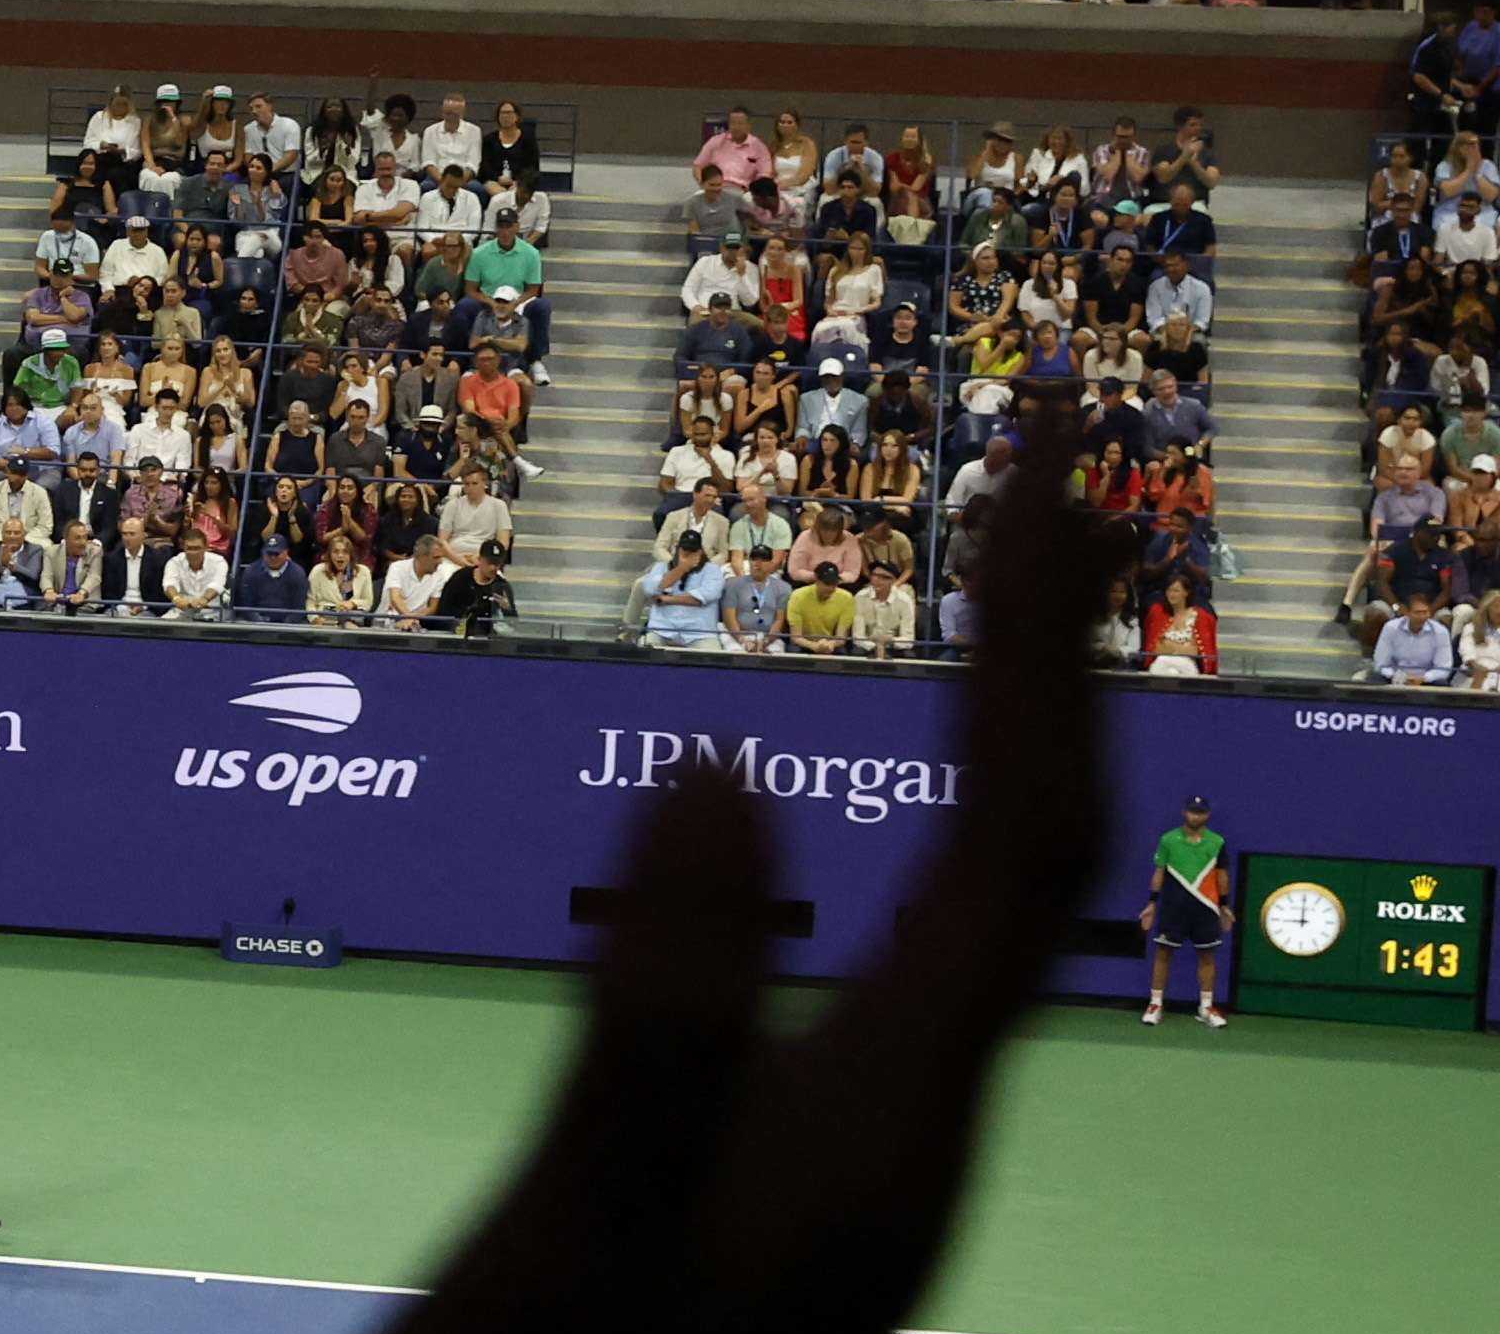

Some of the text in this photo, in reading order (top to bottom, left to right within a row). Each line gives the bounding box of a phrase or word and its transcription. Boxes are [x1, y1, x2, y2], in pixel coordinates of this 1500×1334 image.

[1296, 711, 1455, 736] USOPEN.ORG
[175, 748, 417, 806] us open
[1378, 902, 1465, 922] ROLEX
[237, 937, 302, 953] CHASE
[1379, 939, 1460, 979] 1:43
